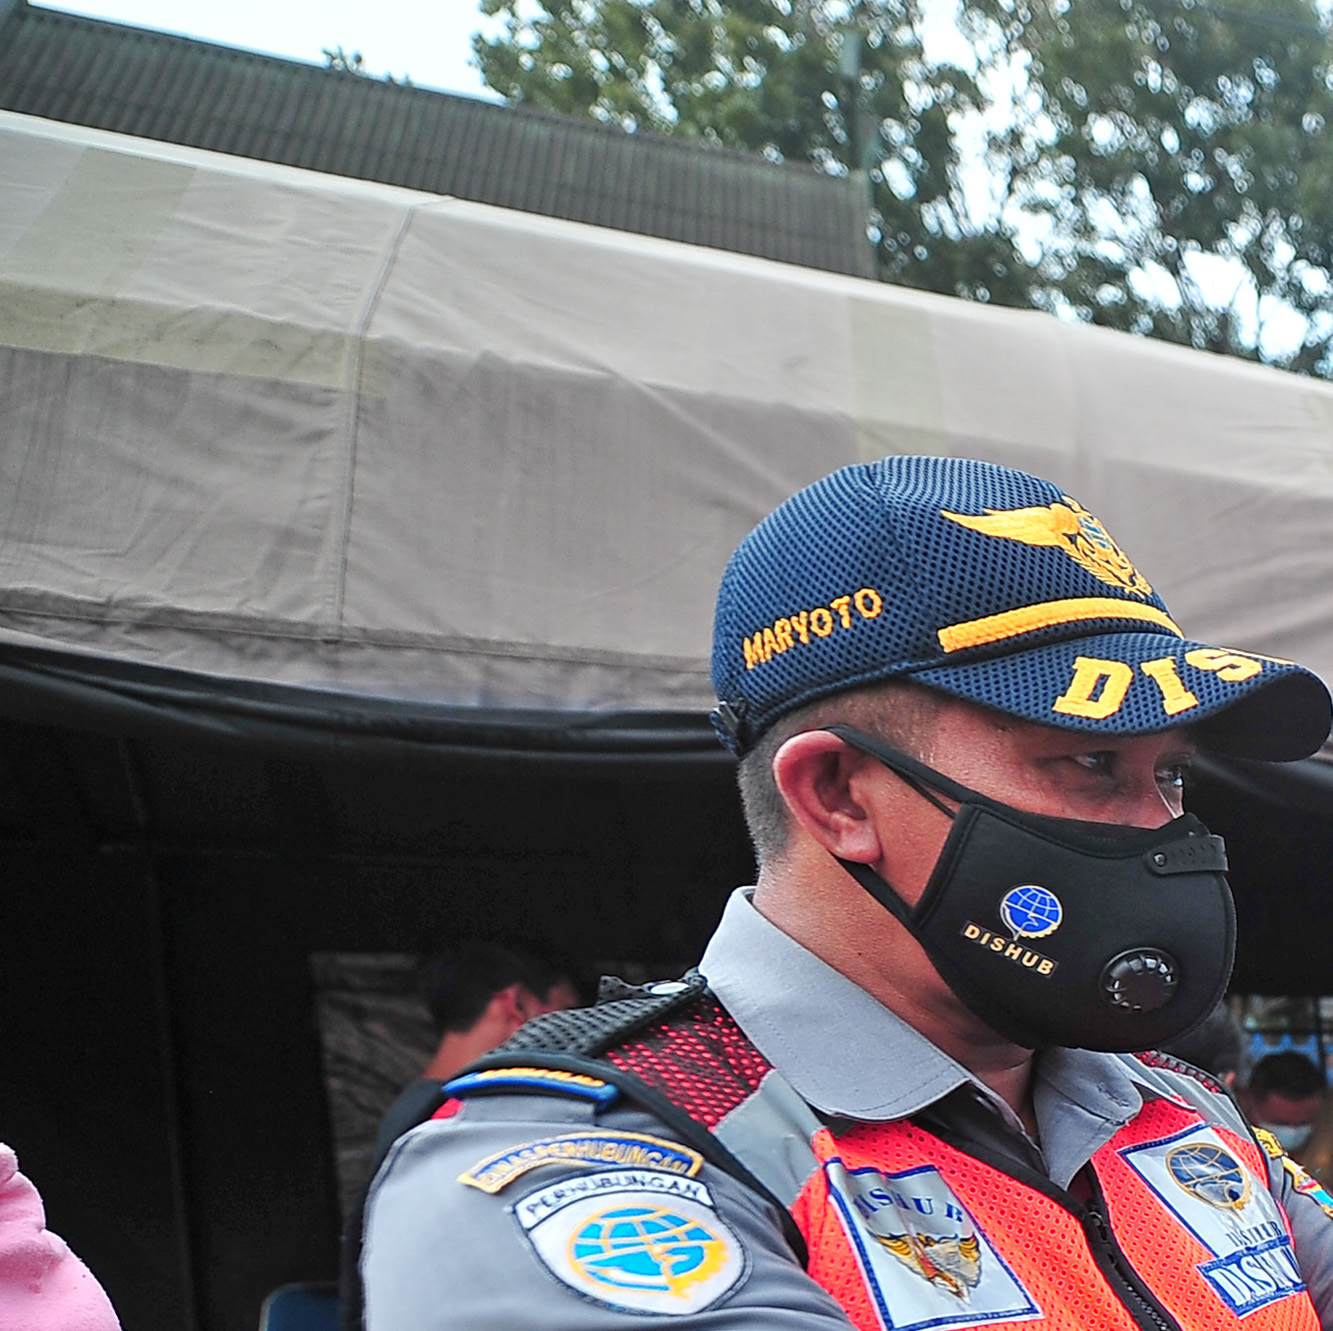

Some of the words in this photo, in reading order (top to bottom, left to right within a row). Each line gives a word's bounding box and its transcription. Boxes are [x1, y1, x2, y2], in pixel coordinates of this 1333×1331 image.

[743, 587, 883, 670] MARYOTO
[1053, 646, 1297, 719] DIS
[961, 921, 1056, 978] DISHUB
[527, 1174, 701, 1215] PERHUBUNGAN
